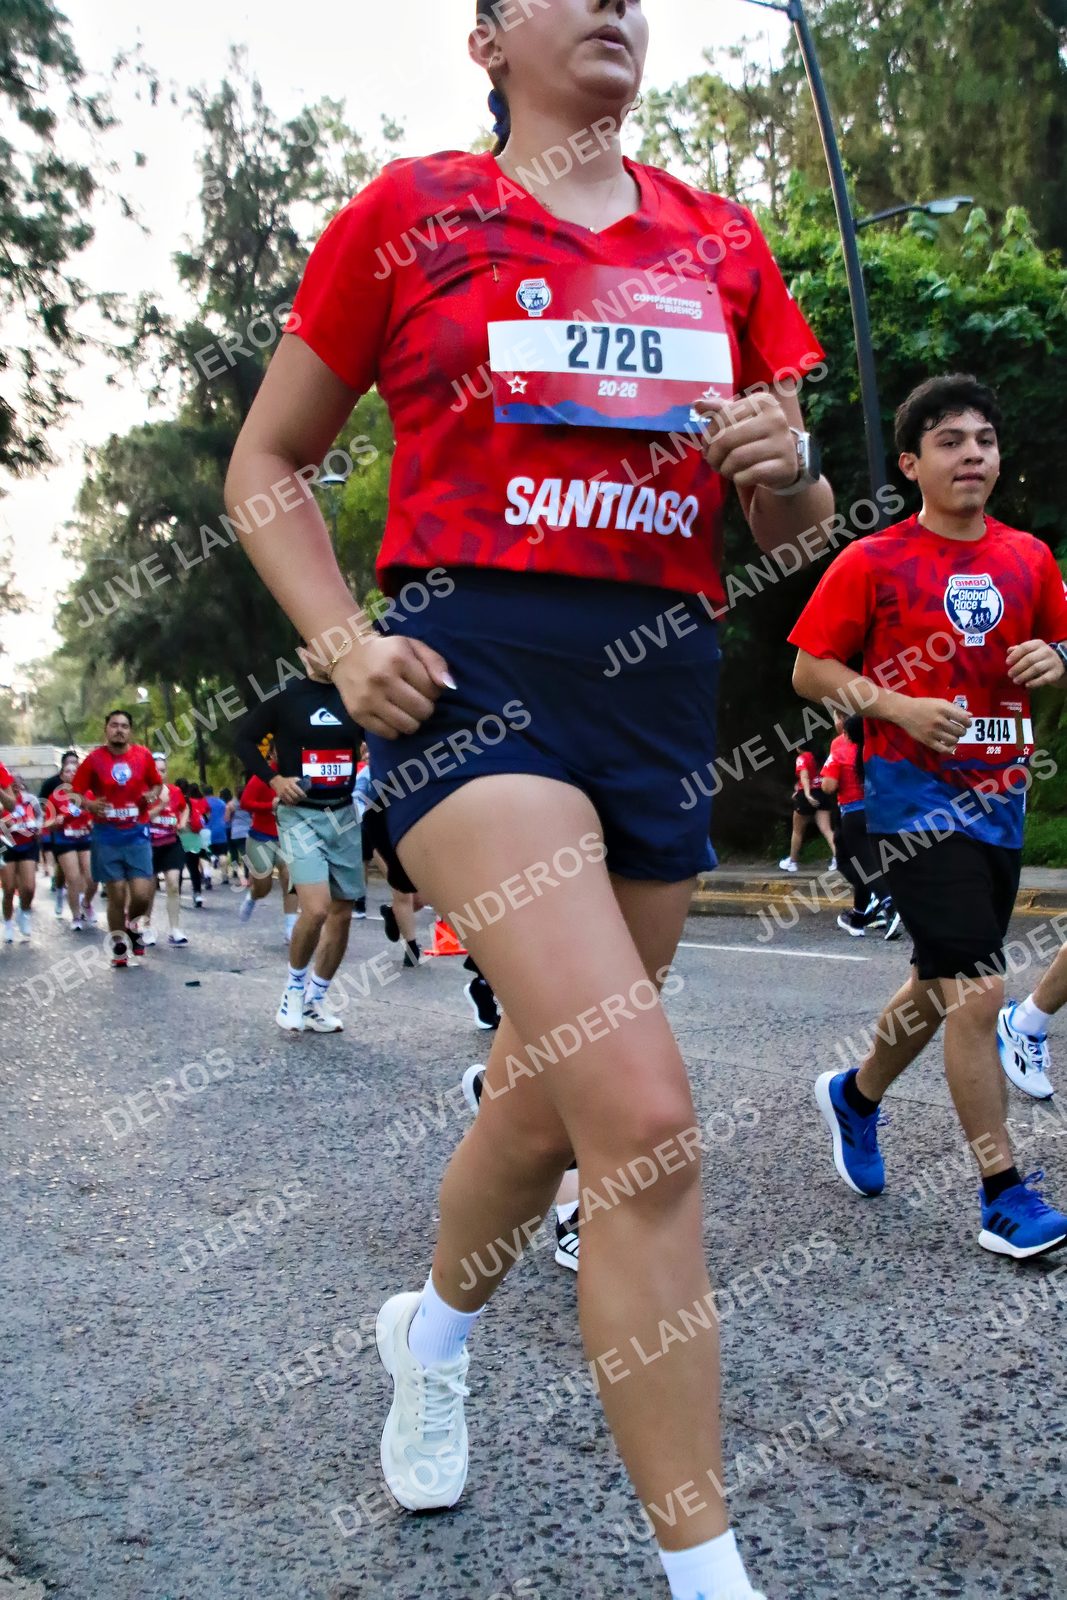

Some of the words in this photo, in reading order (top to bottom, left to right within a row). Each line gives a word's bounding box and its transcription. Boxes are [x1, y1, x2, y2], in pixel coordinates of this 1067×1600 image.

[566, 323, 664, 374] 2726
[504, 476, 699, 538] SANTIAGO
[955, 579, 987, 587] BIMBO
[958, 589, 988, 602] Global
[953, 599, 978, 611] Race
[974, 718, 1010, 742] 3414
[320, 764, 341, 776] 3331
